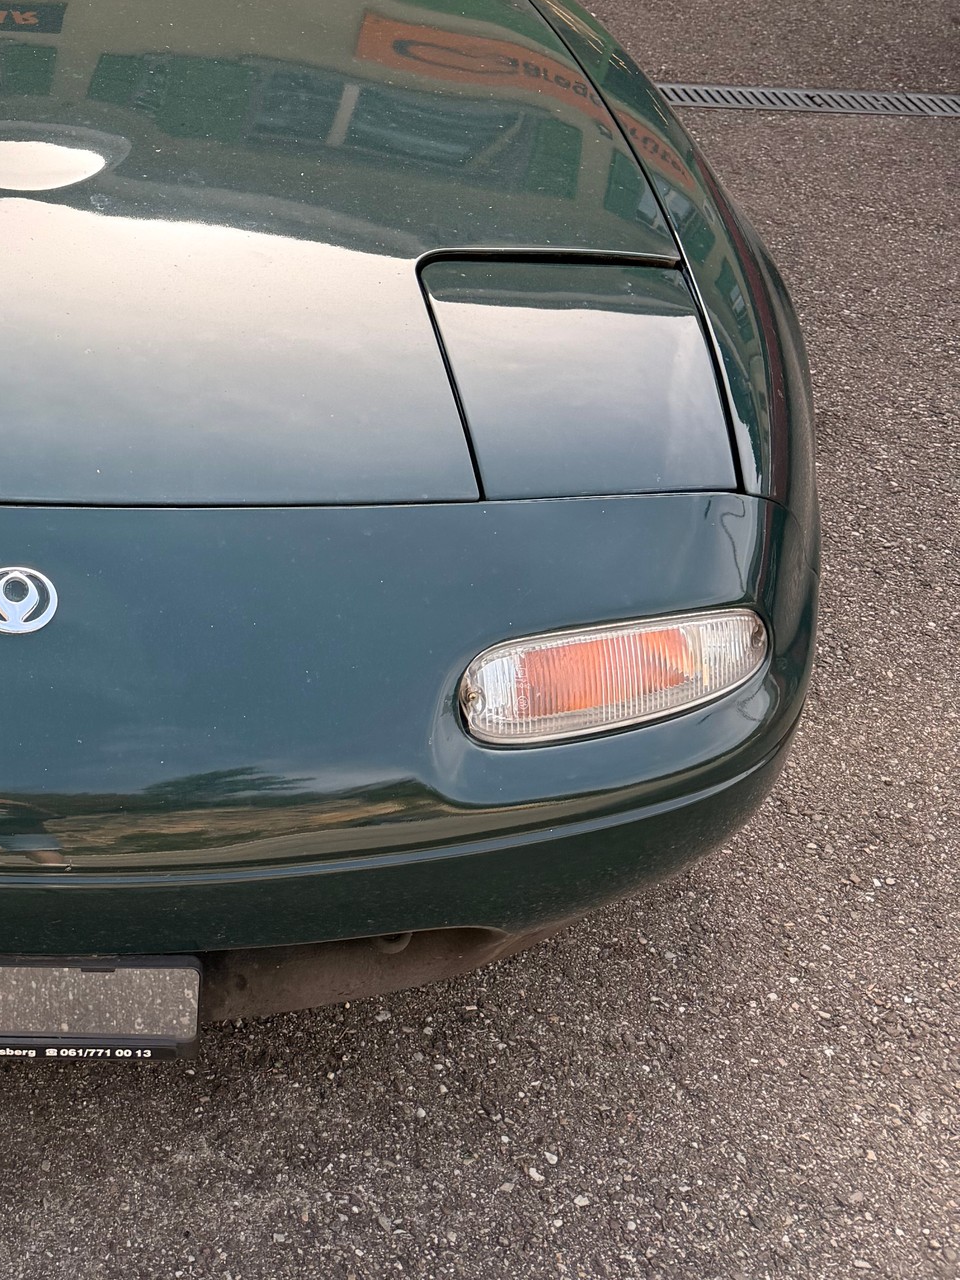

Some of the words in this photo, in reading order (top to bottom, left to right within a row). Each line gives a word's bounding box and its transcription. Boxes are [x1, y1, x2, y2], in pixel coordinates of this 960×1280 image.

[60, 1048, 111, 1057] 061/771
[115, 1049, 132, 1057] 00
[135, 1049, 152, 1058] 13
